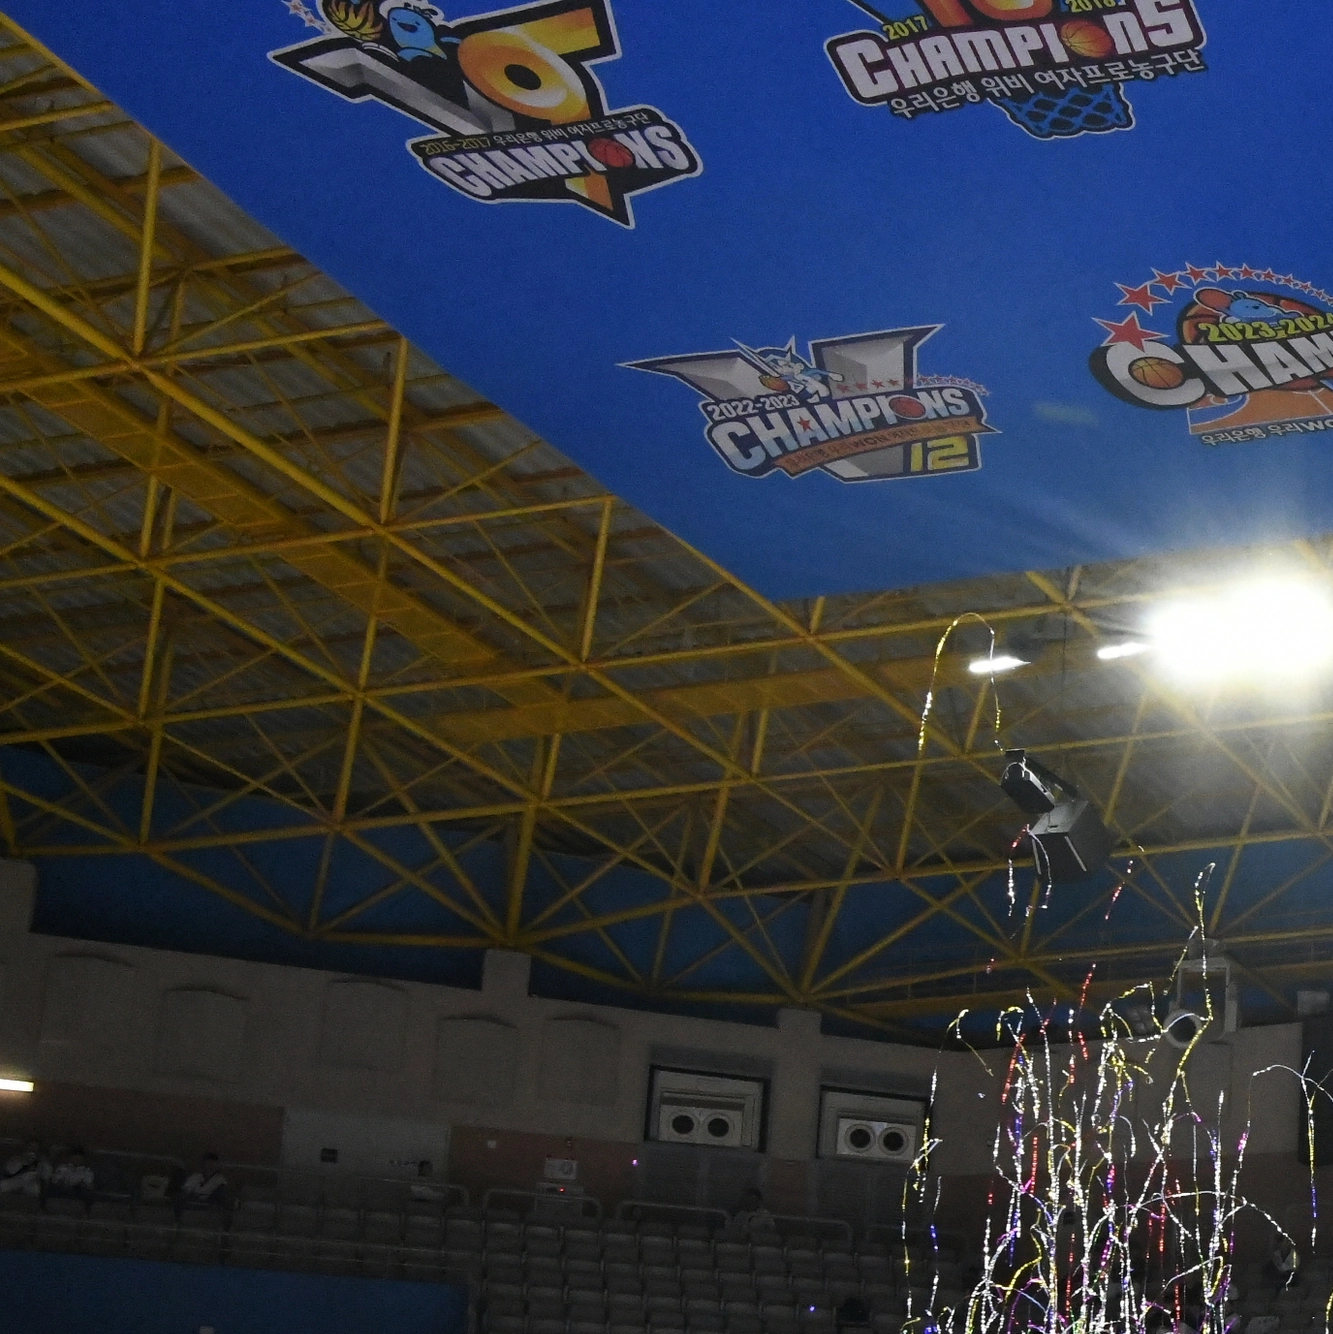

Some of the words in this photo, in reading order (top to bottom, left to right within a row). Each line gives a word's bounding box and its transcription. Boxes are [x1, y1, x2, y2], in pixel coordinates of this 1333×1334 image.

[883, 16, 929, 40] 2017
[892, 81, 981, 119] 우리은행
[984, 72, 1034, 98] 위비
[1035, 51, 1205, 88] 여자프로농구단
[708, 394, 800, 421] 2022-2023
[711, 388, 970, 472] CHAMPIONS
[1201, 428, 1266, 447] 우리은행
[910, 436, 970, 472] 12
